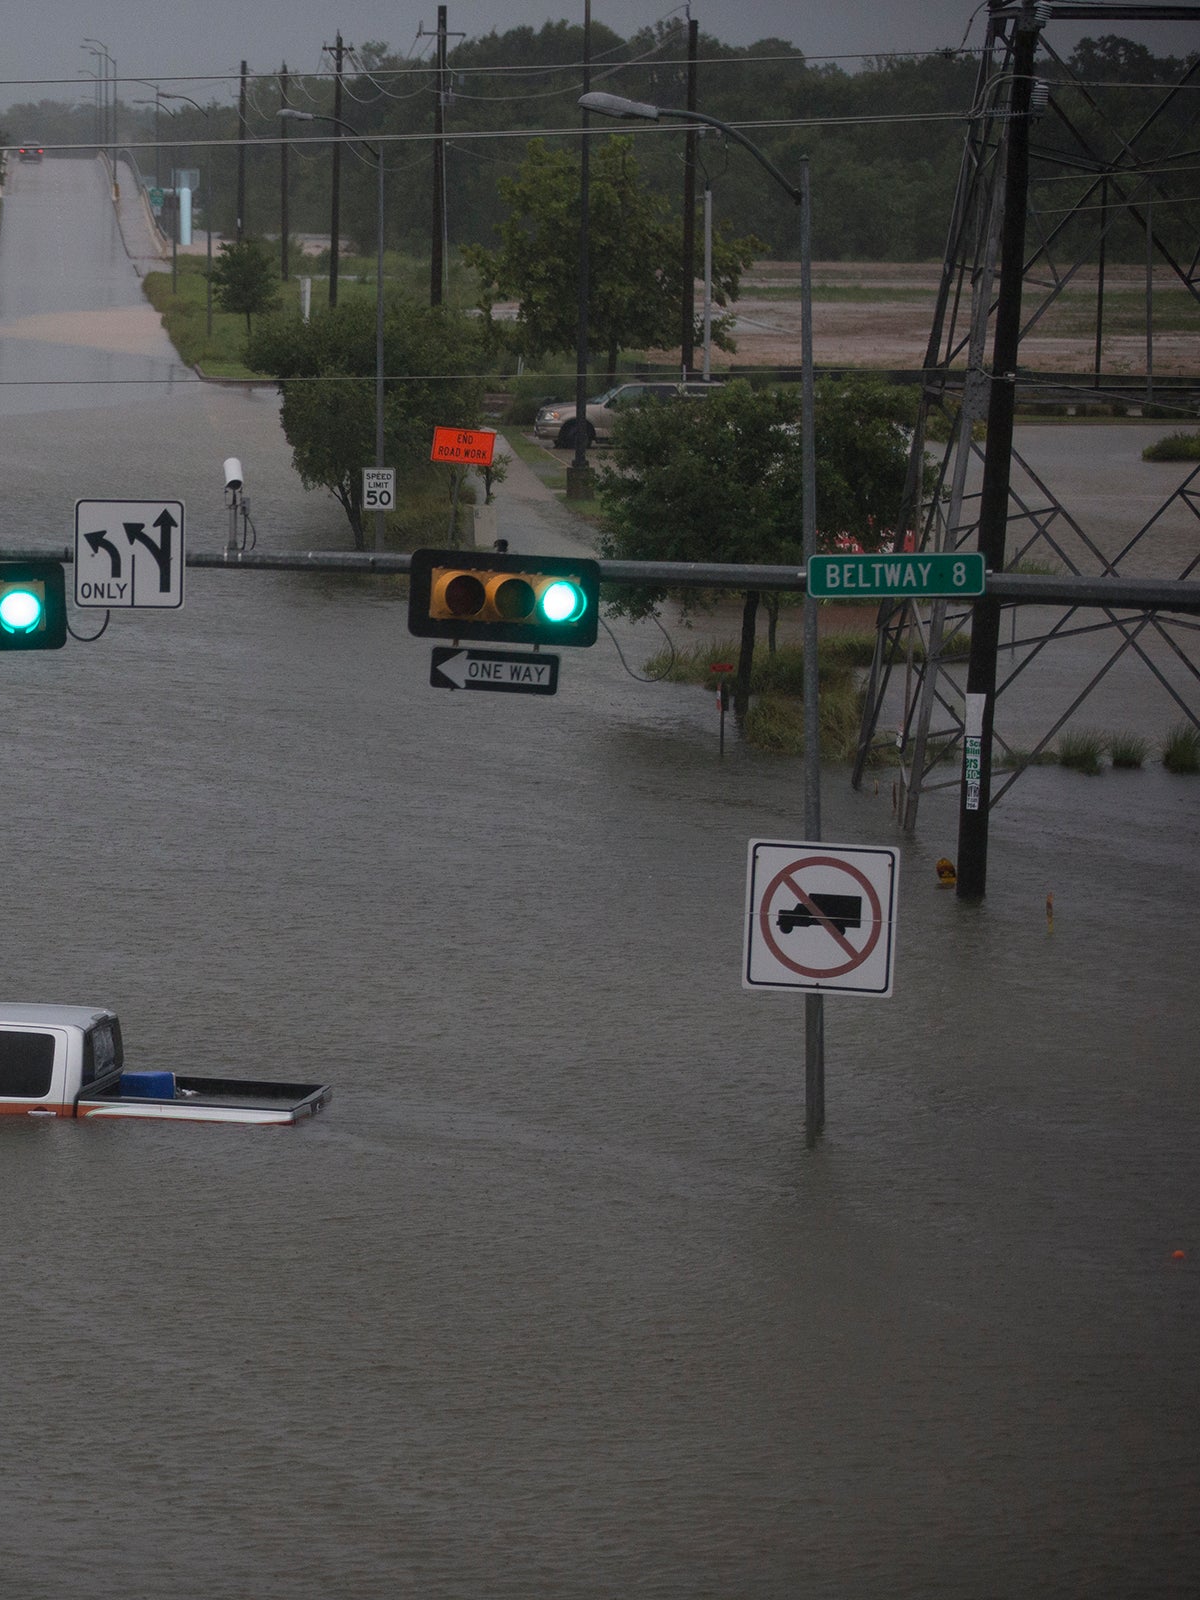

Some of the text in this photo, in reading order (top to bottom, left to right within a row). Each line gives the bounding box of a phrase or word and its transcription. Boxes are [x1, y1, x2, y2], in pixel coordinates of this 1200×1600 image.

[457, 434, 473, 445] END
[438, 446, 487, 459] ROAD WORK
[366, 472, 392, 480] SPEED
[366, 490, 391, 506] 50
[826, 562, 966, 588] BELTWAY 8
[81, 582, 128, 599] ONLY
[468, 662, 546, 682] ONE WAY
